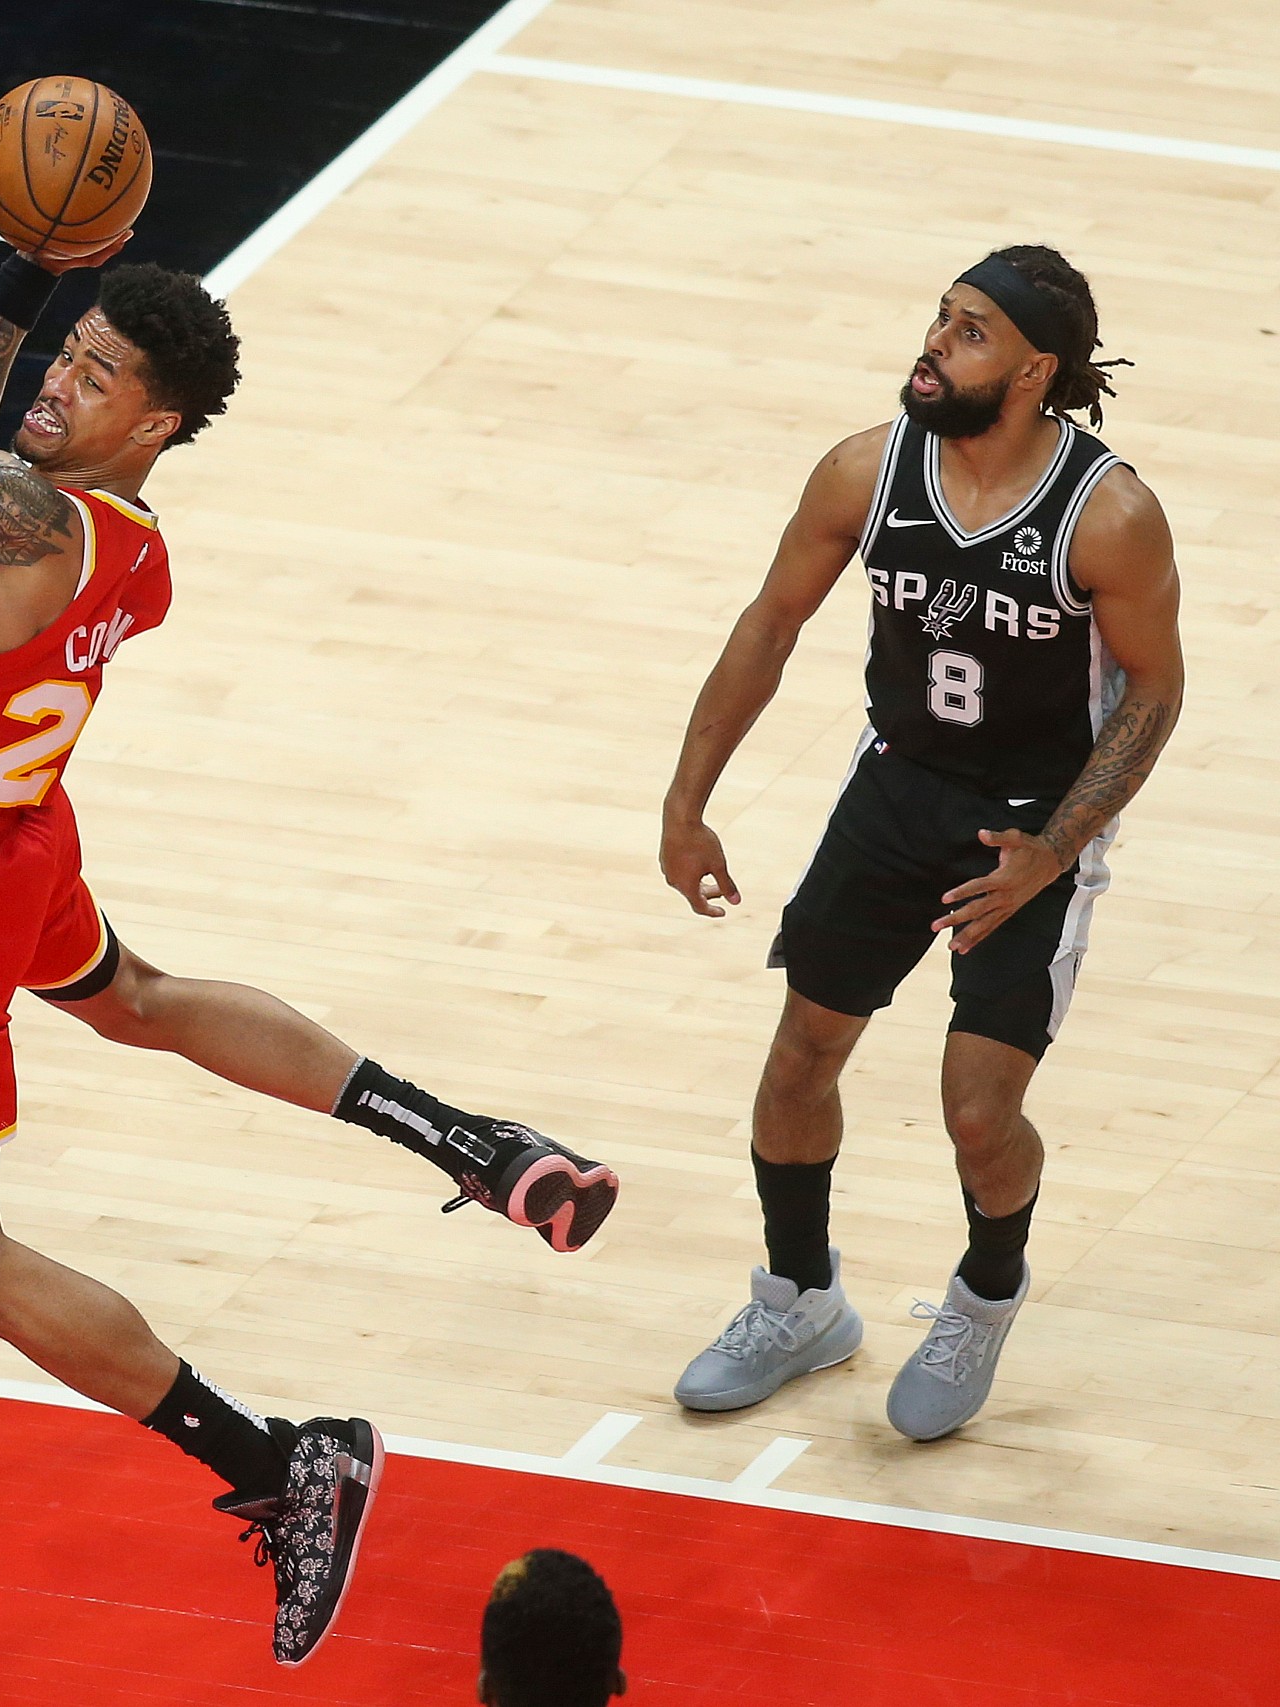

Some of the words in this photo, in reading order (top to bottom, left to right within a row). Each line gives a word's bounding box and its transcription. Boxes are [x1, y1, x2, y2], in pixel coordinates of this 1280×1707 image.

[1001, 552, 1048, 576] Frost
[867, 567, 1062, 641] SPURS
[927, 649, 984, 728] 8
